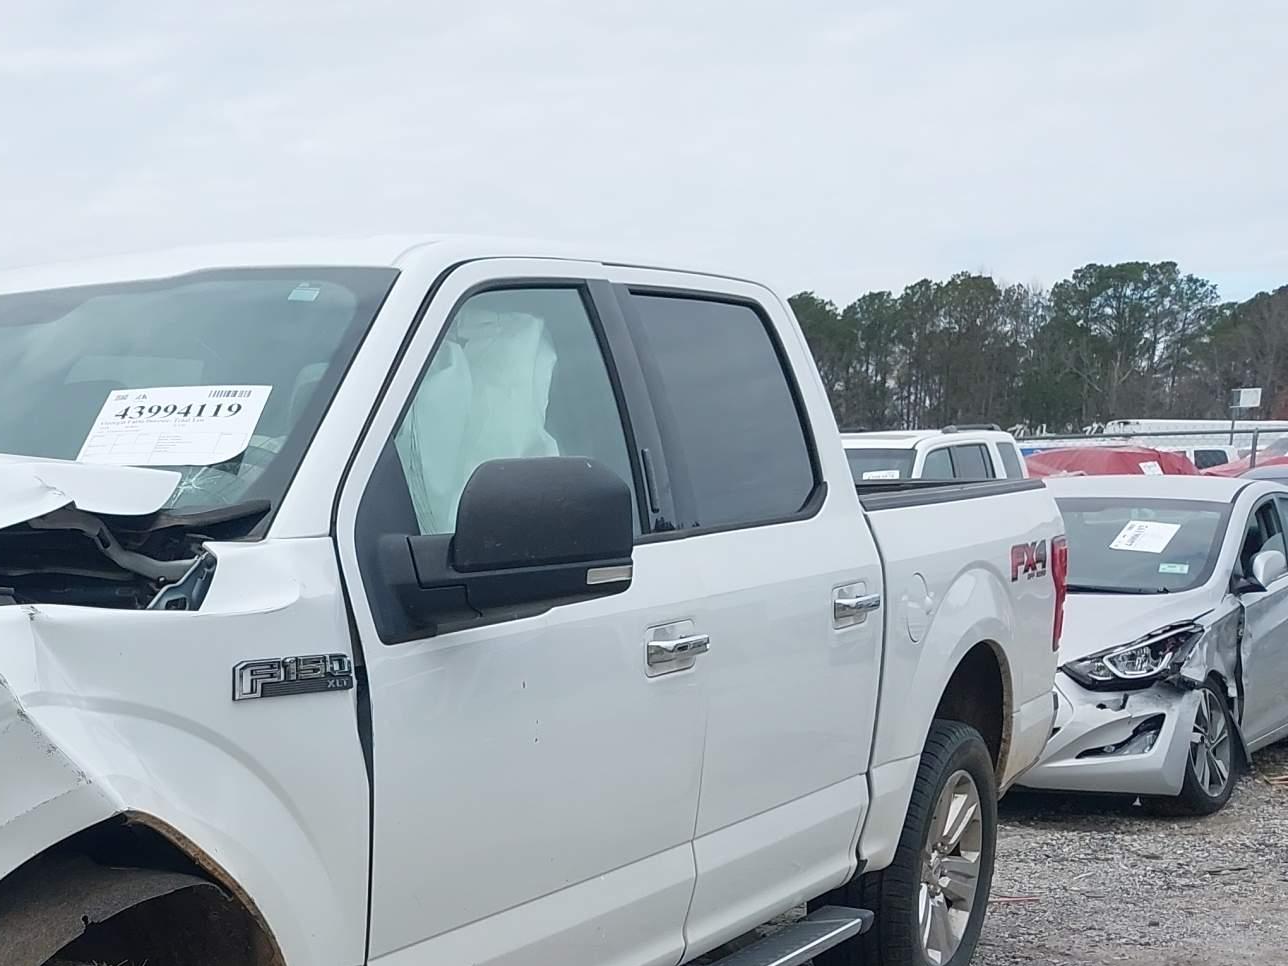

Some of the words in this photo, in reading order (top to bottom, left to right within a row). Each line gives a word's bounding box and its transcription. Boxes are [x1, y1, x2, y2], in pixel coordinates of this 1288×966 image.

[114, 403, 242, 420] 43994119
[1011, 539, 1047, 582] FX4
[327, 679, 348, 688] XLT
